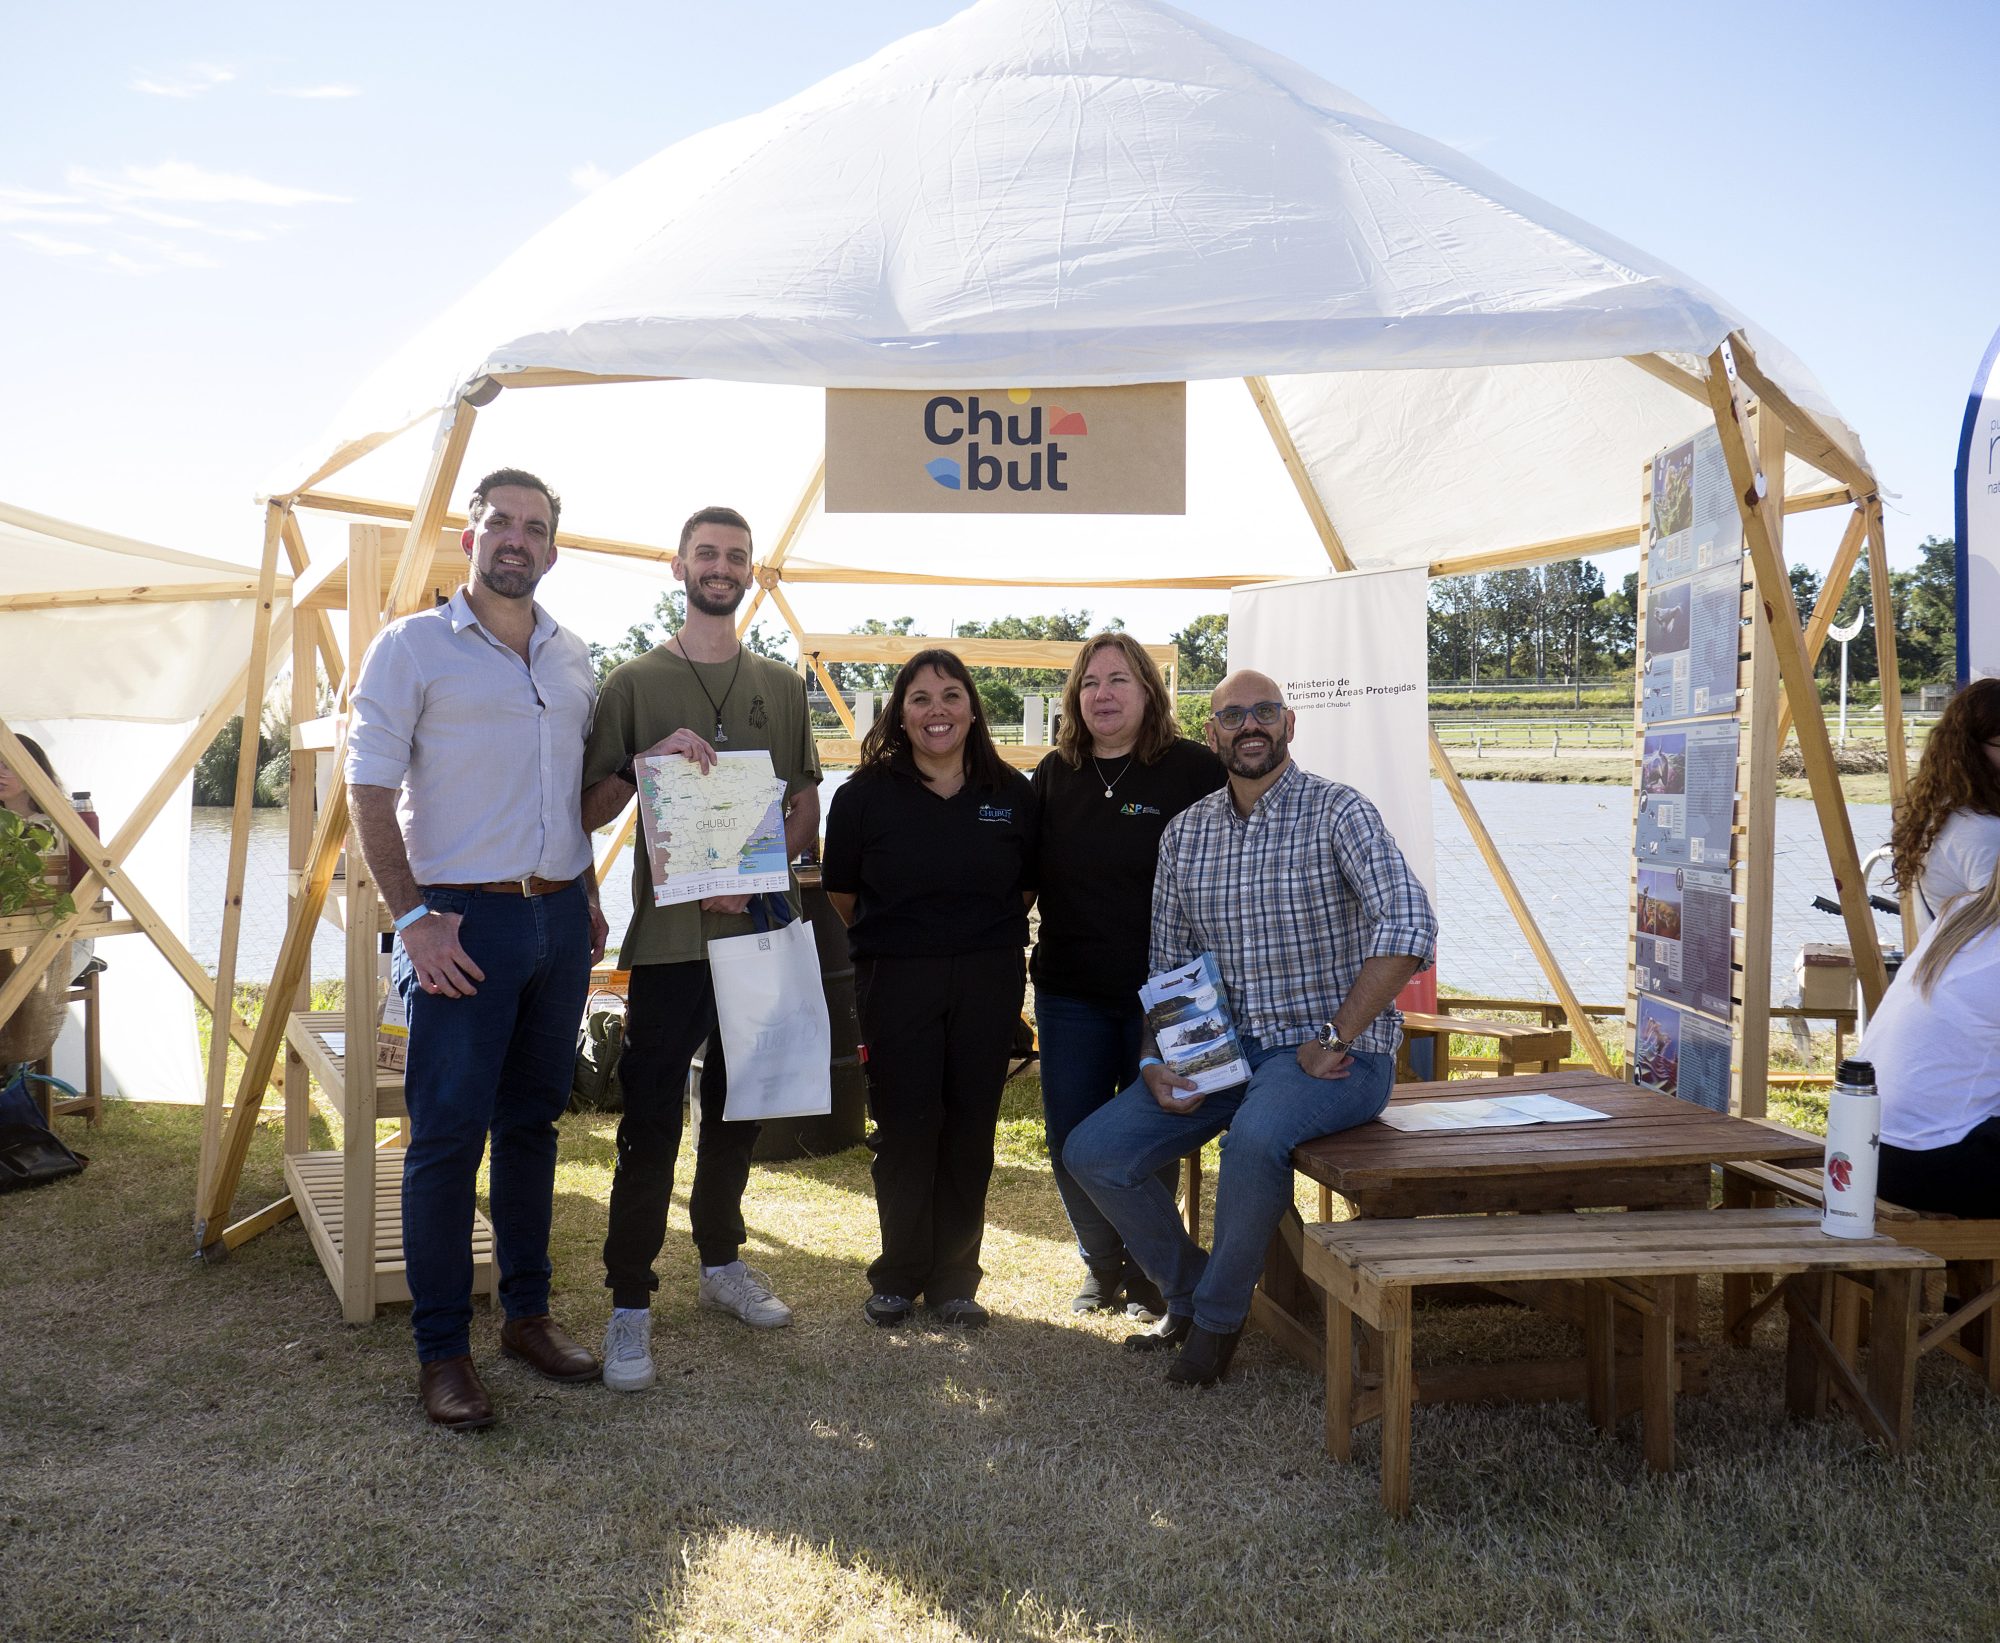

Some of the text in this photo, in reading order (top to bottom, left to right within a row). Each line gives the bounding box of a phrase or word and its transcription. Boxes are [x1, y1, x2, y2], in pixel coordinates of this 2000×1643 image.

[924, 396, 1042, 446] Chu
[968, 441, 1068, 492] but
[1287, 678, 1350, 690] Ministerio de
[1287, 683, 1417, 701] Turismo y Áreas Protegidas
[696, 817, 737, 830] CHUBUT
